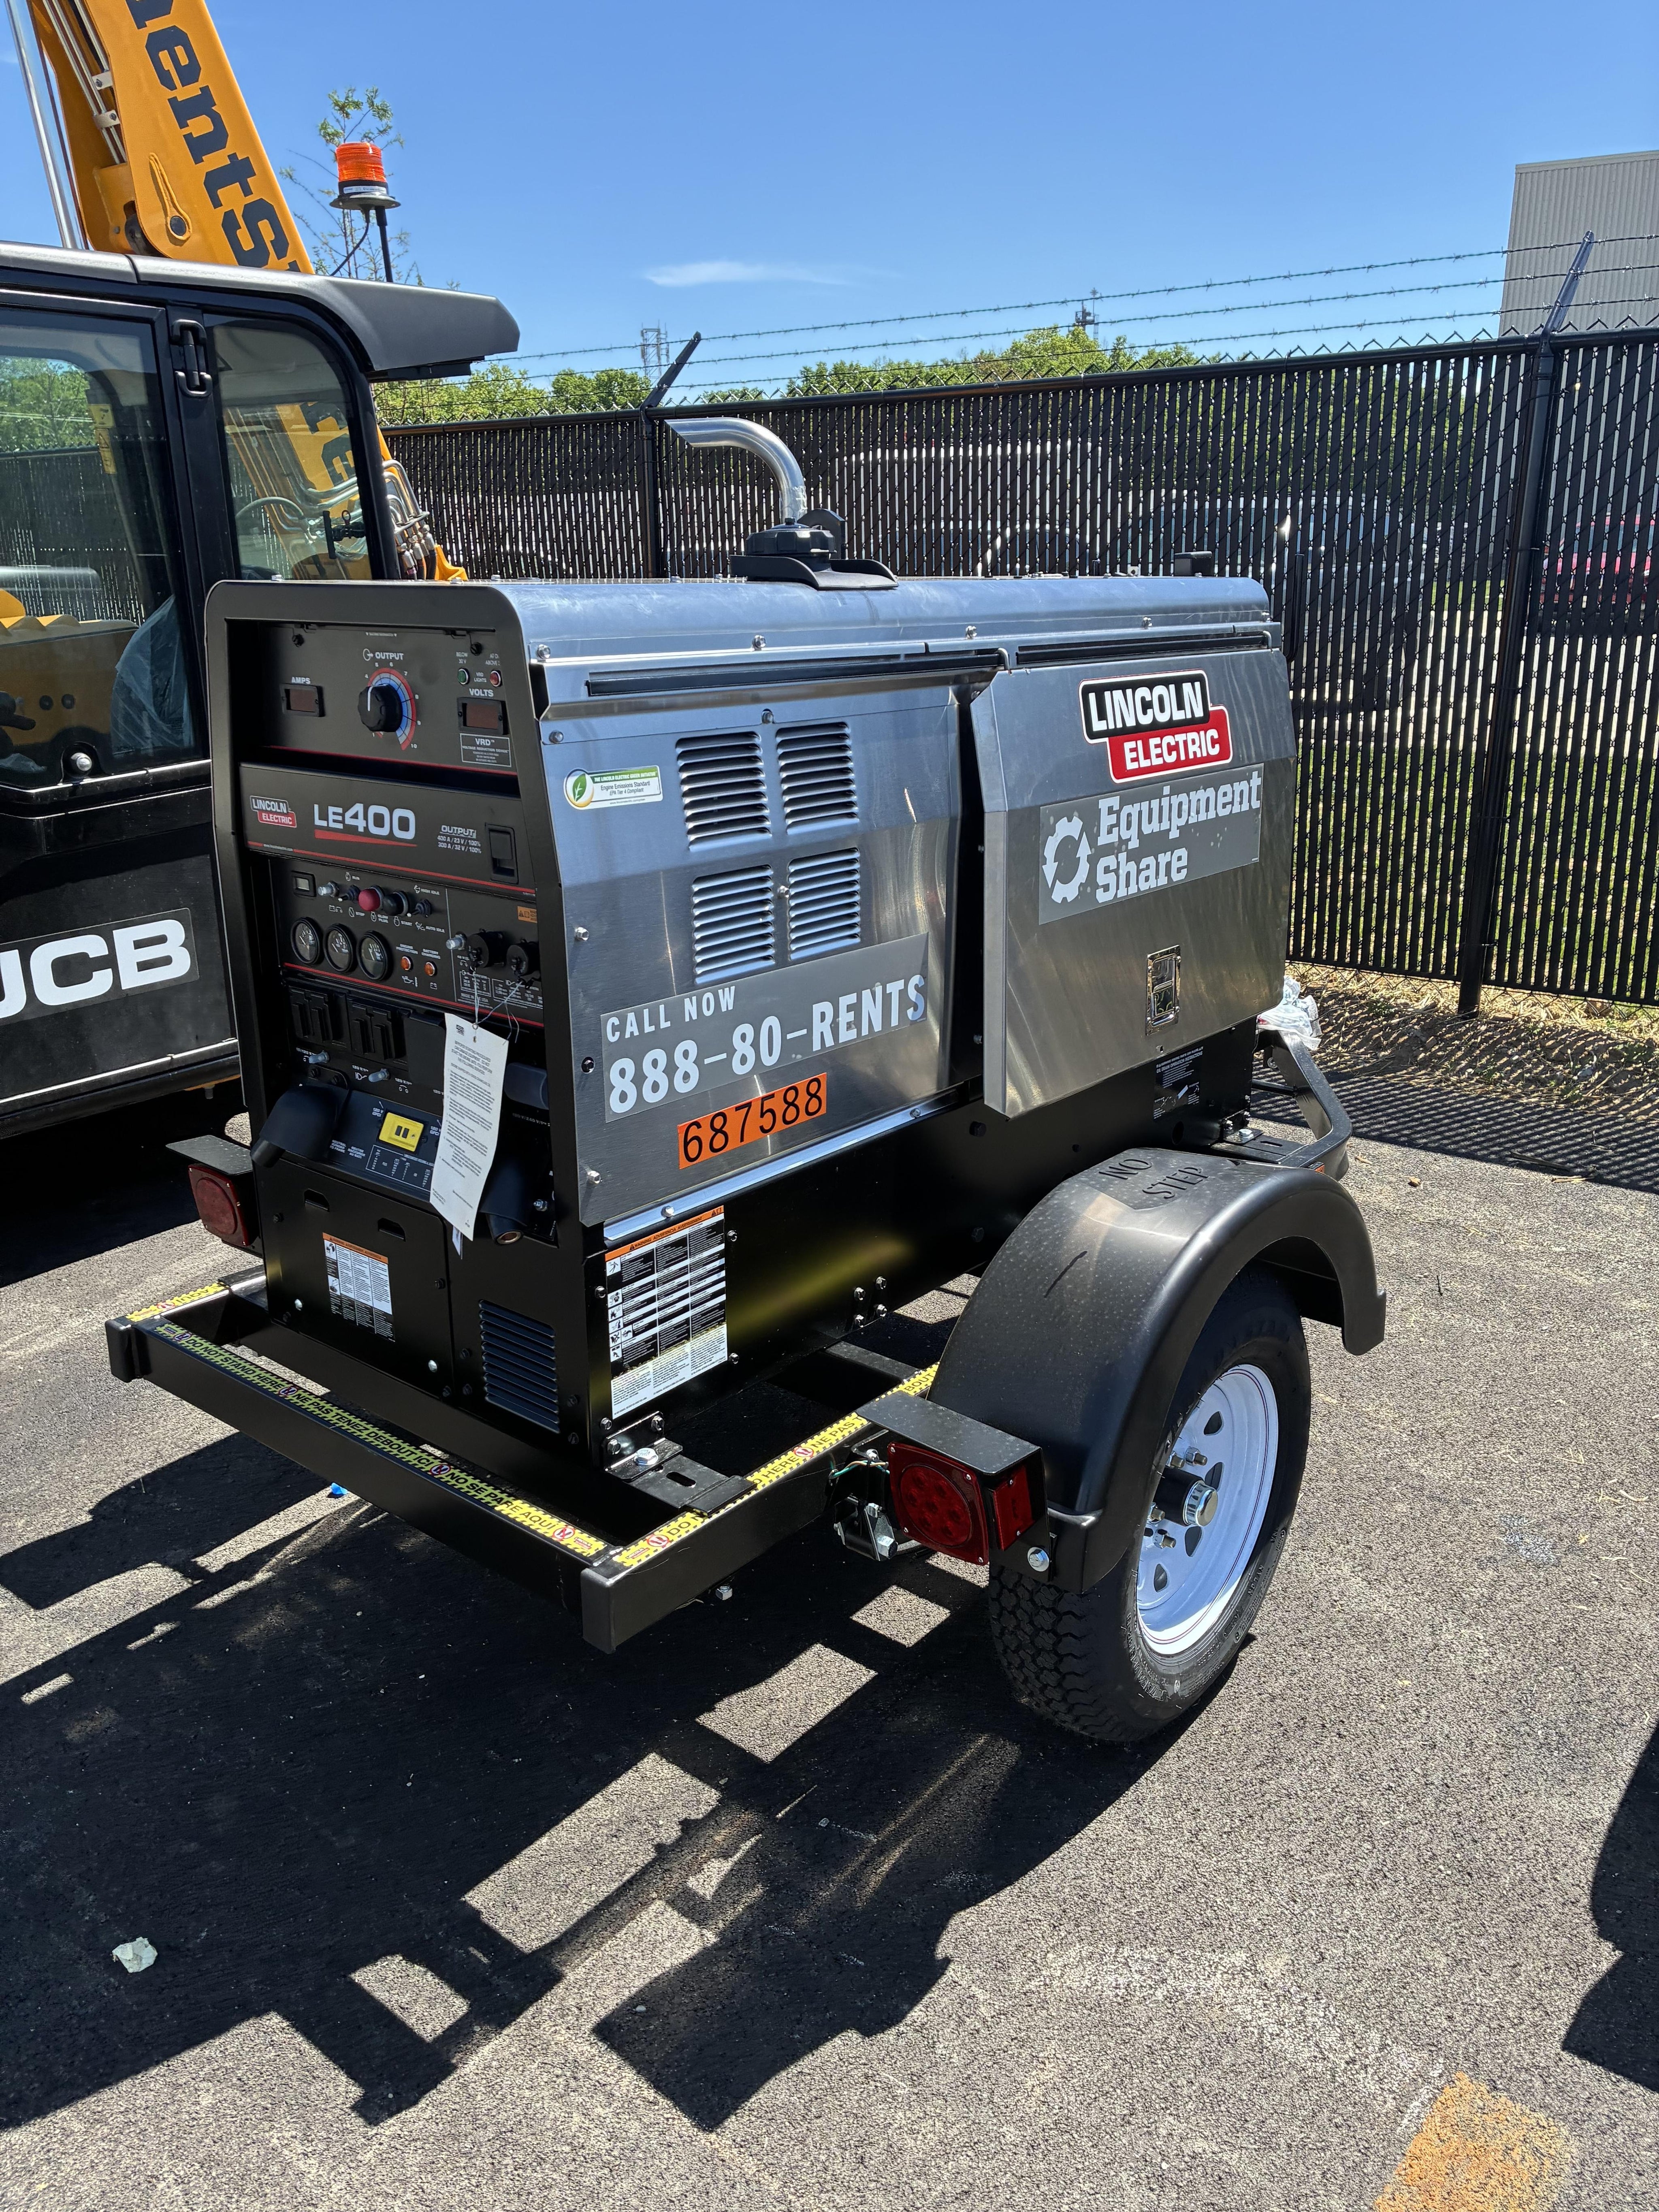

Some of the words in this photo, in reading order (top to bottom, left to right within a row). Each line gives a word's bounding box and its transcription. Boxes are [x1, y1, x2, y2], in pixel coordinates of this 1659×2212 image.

[375, 652, 403, 660] OUTPUT
[469, 688, 494, 697] VOLTS
[1088, 681, 1204, 732] LINCOLN
[1123, 729, 1220, 770] ELECTRIC
[252, 799, 287, 813] LINCOLN
[262, 813, 292, 825] ELECTRIC
[314, 803, 416, 840] LE400
[1097, 771, 1261, 849] Equipment
[441, 825, 474, 836] OUTPUT
[1096, 847, 1188, 903] Share
[0, 919, 191, 1018] JCB
[606, 1004, 671, 1042] CALL
[684, 986, 736, 1023] NOW
[609, 974, 925, 1113] 888-80-RENTS
[683, 1077, 823, 1163] 687588
[1099, 1159, 1152, 1180] NO
[1142, 1167, 1209, 1199] STEP
[186, 1338, 203, 1348] DO
[200, 1346, 225, 1359] NOT
[220, 1357, 256, 1375] STAND
[253, 1374, 285, 1389] HERE
[292, 1393, 311, 1402] NE
[308, 1401, 333, 1414] PAS
[331, 1413, 370, 1433] TENEZ
[366, 1431, 420, 1457] DEBOUT
[416, 1455, 435, 1466] ICI
[810, 1436, 832, 1448] NE
[830, 1421, 855, 1437] PAS
[761, 1456, 800, 1478] HERE
[446, 1472, 468, 1484] NO
[466, 1482, 488, 1495] SE
[486, 1492, 523, 1512] PARE
[521, 1512, 559, 1529] AQUÍ
[667, 1522, 691, 1535] DO
